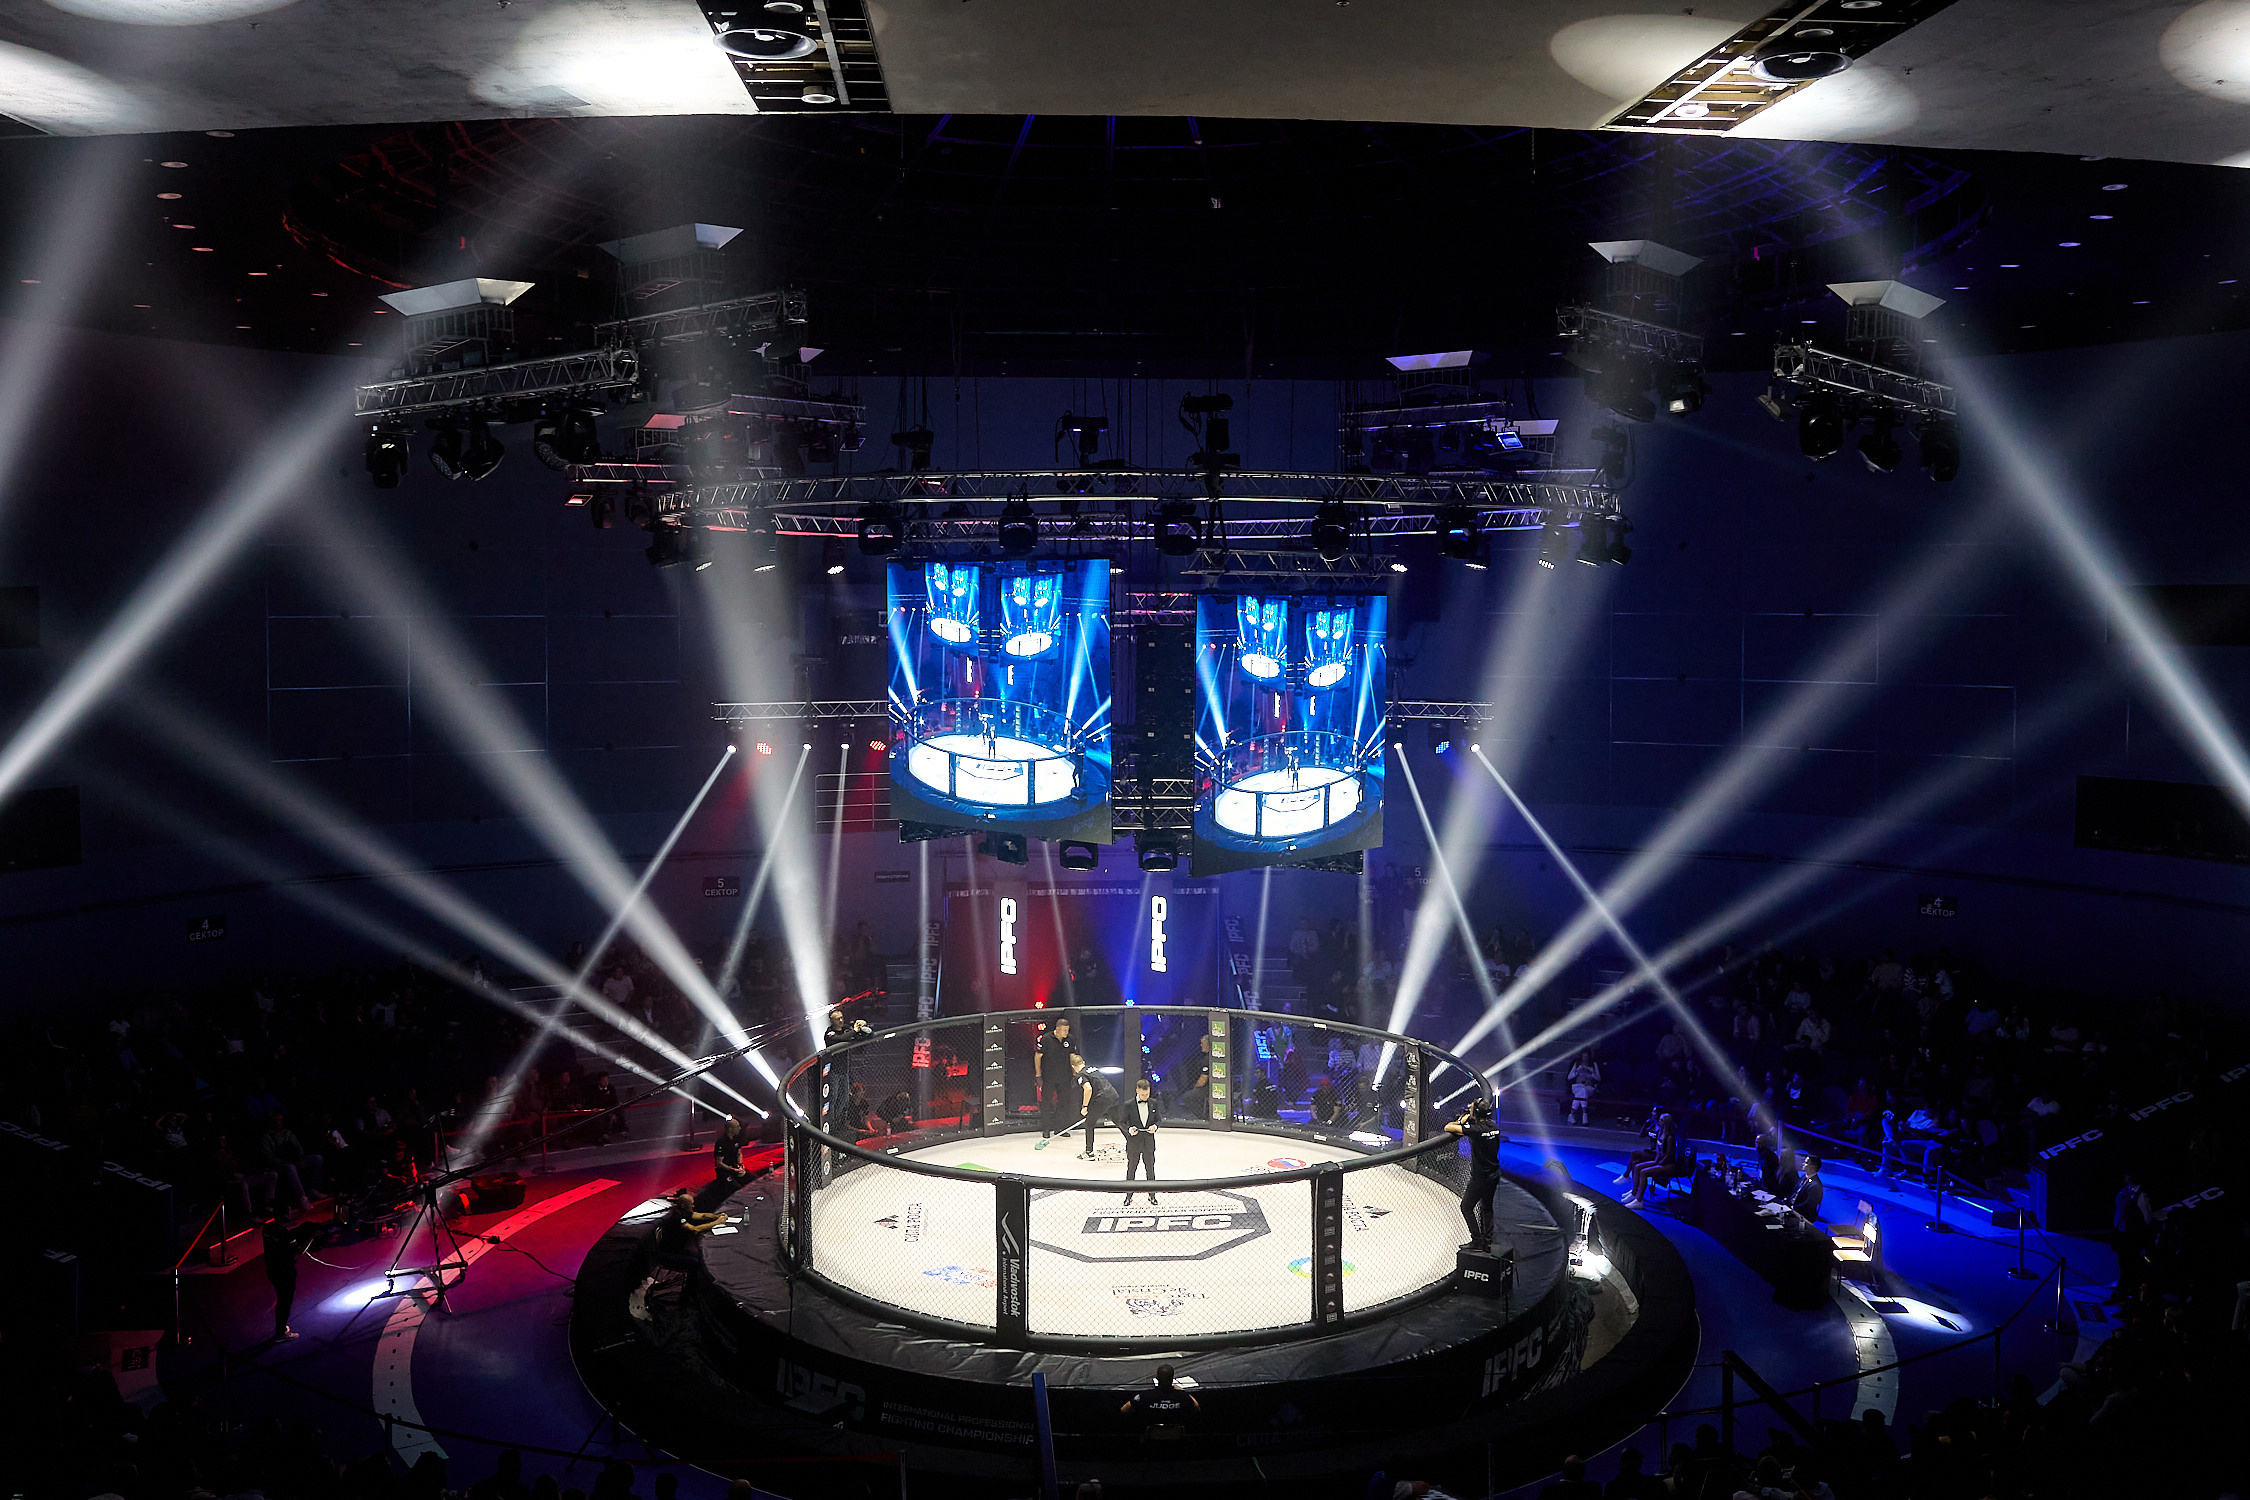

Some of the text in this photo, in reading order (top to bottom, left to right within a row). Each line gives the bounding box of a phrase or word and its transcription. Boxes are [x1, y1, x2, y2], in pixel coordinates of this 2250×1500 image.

[704, 888, 738, 898] СЕКТОР
[717, 878, 725, 888] 5
[1921, 906, 1955, 917] СЕКТОР
[1934, 897, 1944, 908] 4
[190, 928, 225, 941] СЕКТОР
[201, 919, 209, 930] 4
[1000, 897, 1017, 975] IPFC
[1150, 895, 1167, 973] IPFC
[911, 1037, 932, 1069] IPFC
[2129, 1091, 2195, 1122] IPFC
[2039, 1129, 2104, 1160] IPFC
[103, 1160, 173, 1191] IPFC
[1097, 1214, 1232, 1232] IPFC
[1010, 1258, 1021, 1318] Vladivostok
[1463, 1269, 1490, 1282] IPFC
[881, 1412, 1035, 1445] FIGHTING CHAMPIONSHIP
[883, 1400, 1035, 1431] INTERNATIONAL PROFESSIONAL
